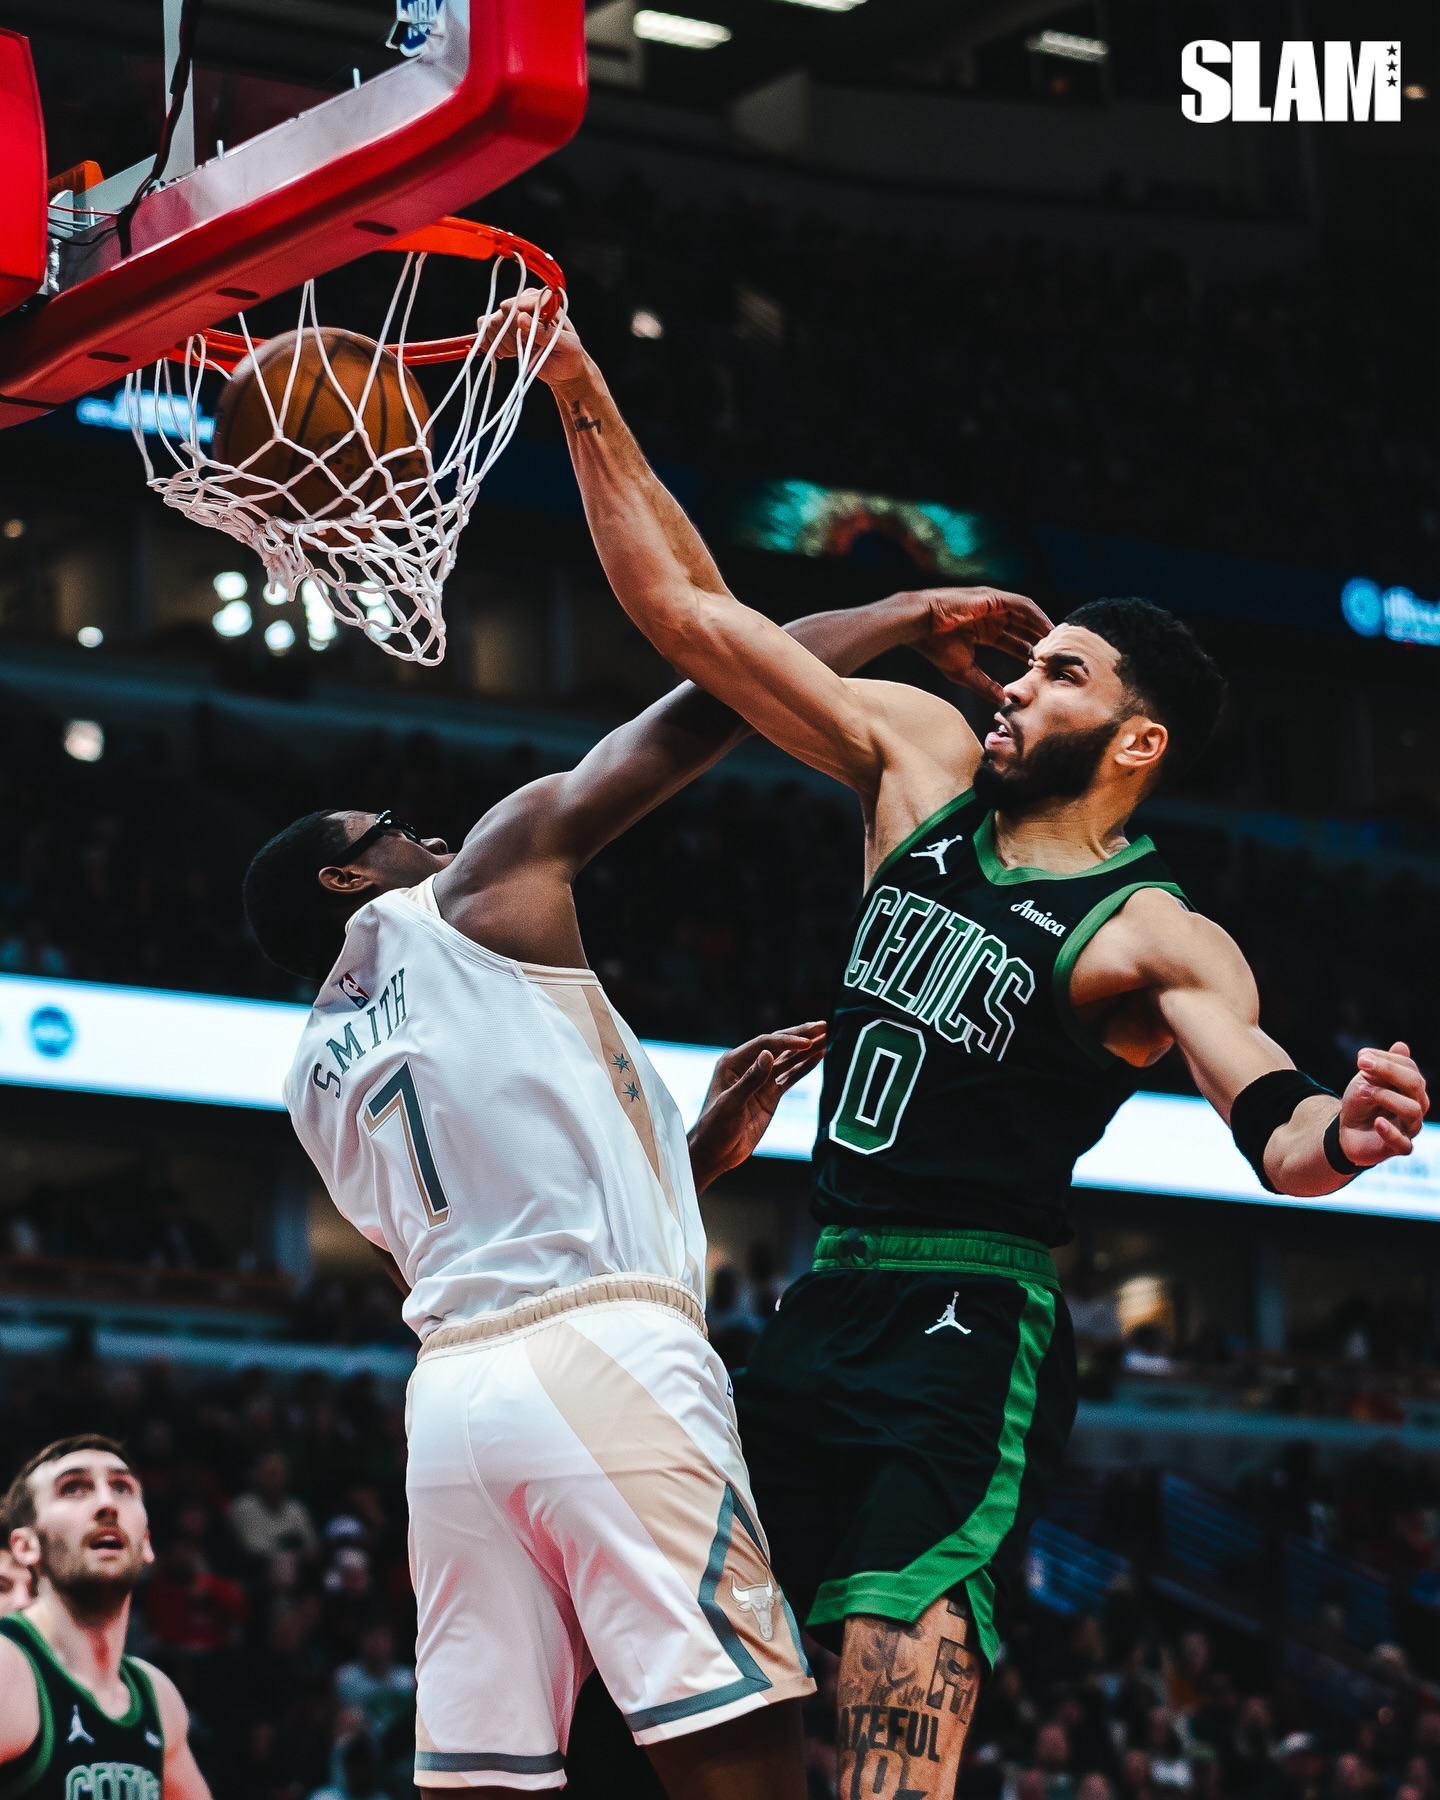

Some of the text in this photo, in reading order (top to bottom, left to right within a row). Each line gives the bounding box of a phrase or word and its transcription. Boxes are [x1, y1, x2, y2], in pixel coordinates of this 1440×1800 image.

[843, 885, 1036, 1062] CELTICS
[1010, 900, 1067, 937] Amica
[312, 967, 408, 1099] SMITH
[828, 1017, 926, 1156] 0
[362, 1056, 451, 1231] 7
